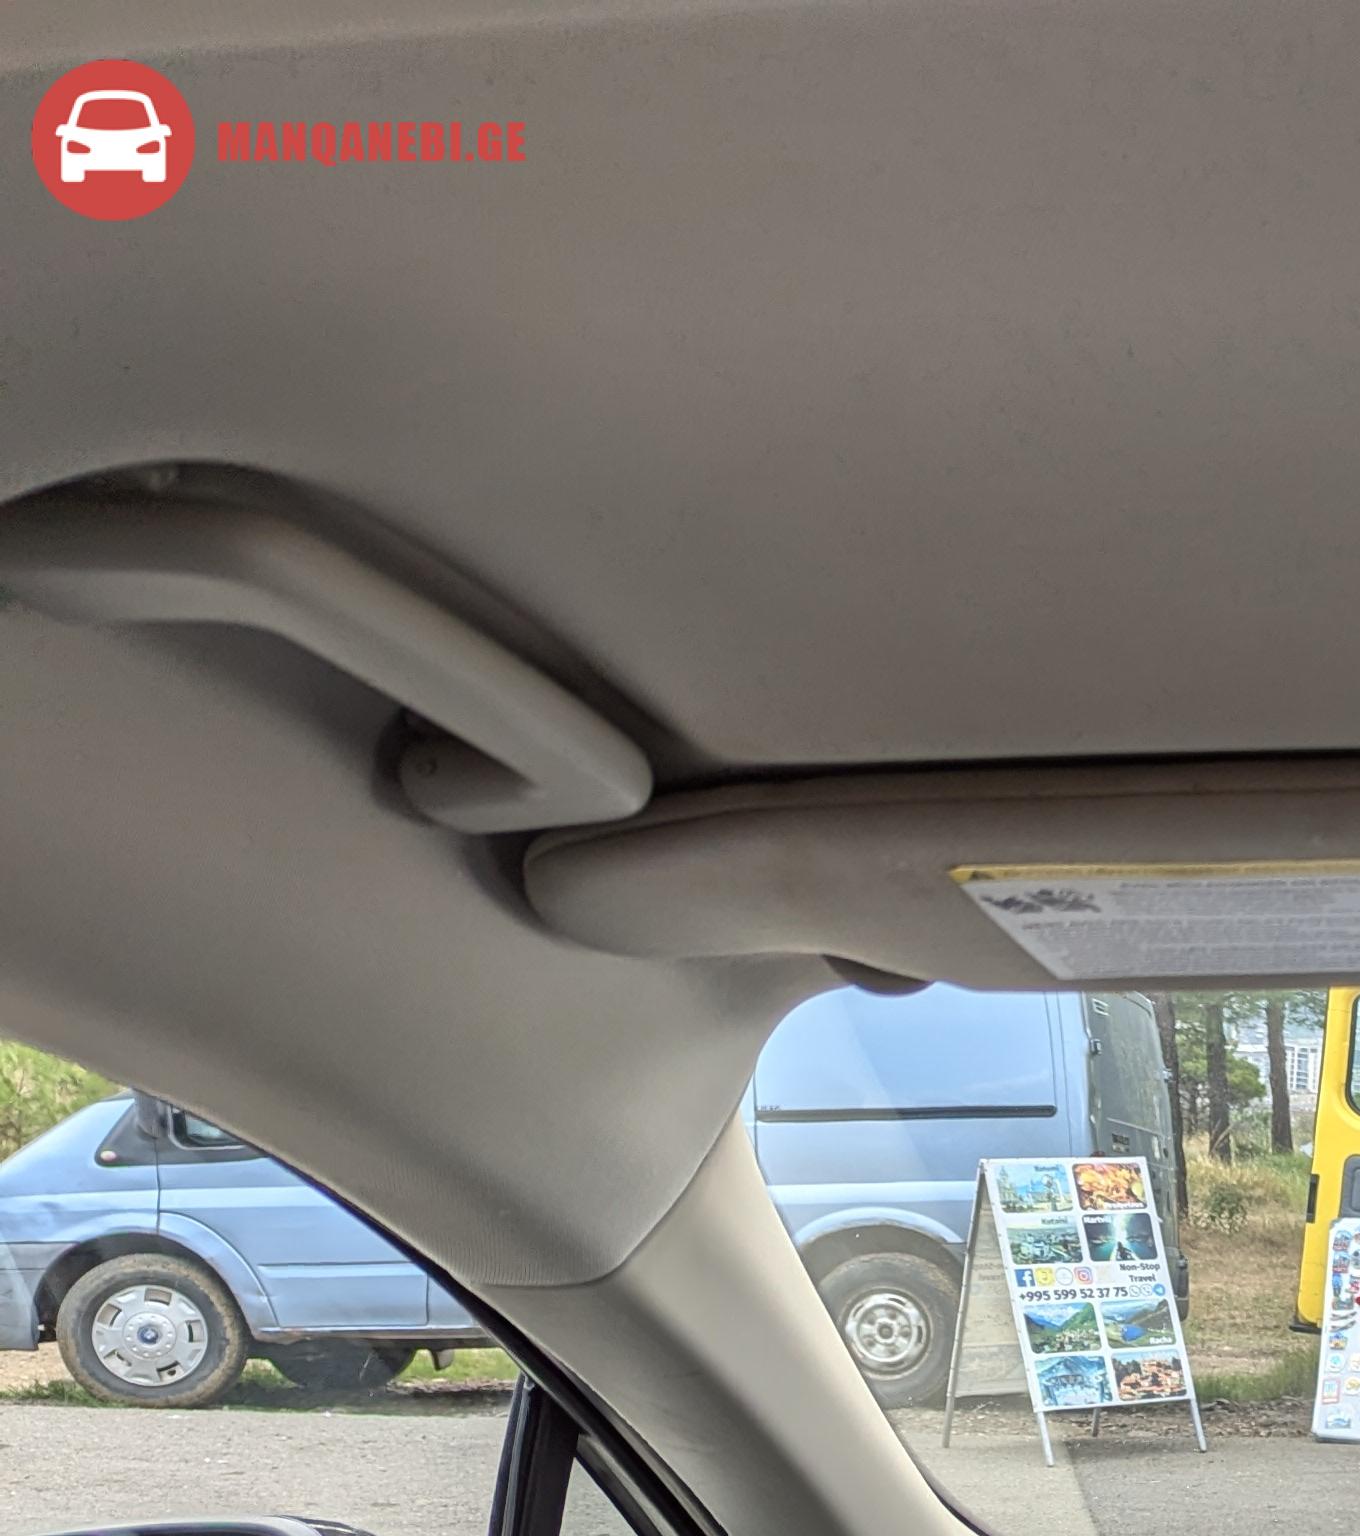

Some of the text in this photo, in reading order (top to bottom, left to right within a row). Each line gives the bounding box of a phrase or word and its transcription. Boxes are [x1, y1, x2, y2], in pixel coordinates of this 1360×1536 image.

[1119, 1263, 1161, 1272] Non-Stop
[1128, 1273, 1157, 1283] Travel
[1019, 1286, 1128, 1301] +995 599 52 37 75
